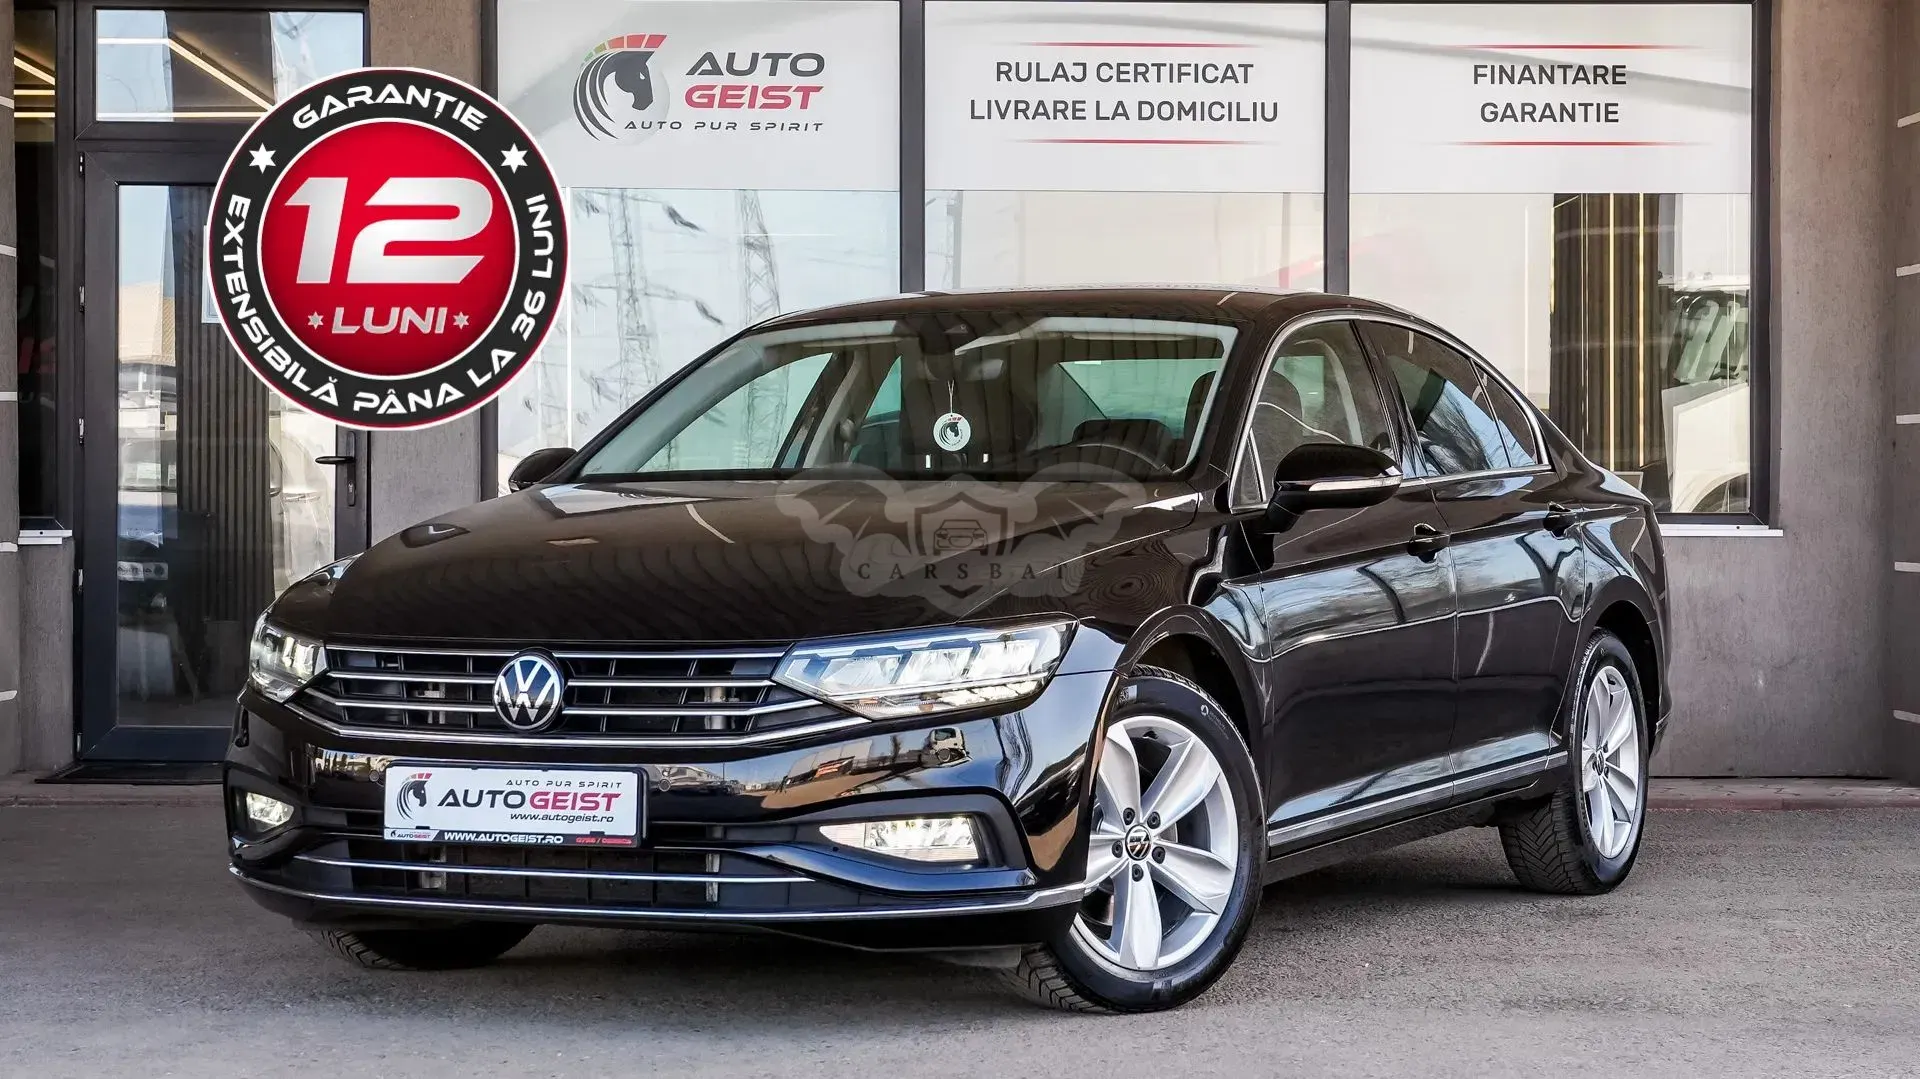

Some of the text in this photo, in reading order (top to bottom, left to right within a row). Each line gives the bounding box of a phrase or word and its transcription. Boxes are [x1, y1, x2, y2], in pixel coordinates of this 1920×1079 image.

[685, 51, 825, 77] AUTO
[996, 61, 1254, 84] RULAJ CERTIFICAT
[1473, 64, 1627, 85] FINANTARE
[684, 84, 824, 110] GEIST
[970, 99, 1278, 122] LIVRARE LA DOMICILIU
[1480, 102, 1619, 123] GARANTIE
[624, 120, 824, 132] AUTO PUR SPIRIT
[506, 779, 622, 789] AUTO PUR SPIRIT
[510, 812, 614, 824] www.autogeist.ro
[444, 832, 564, 844] WWW.AUTOGEIST.RO
